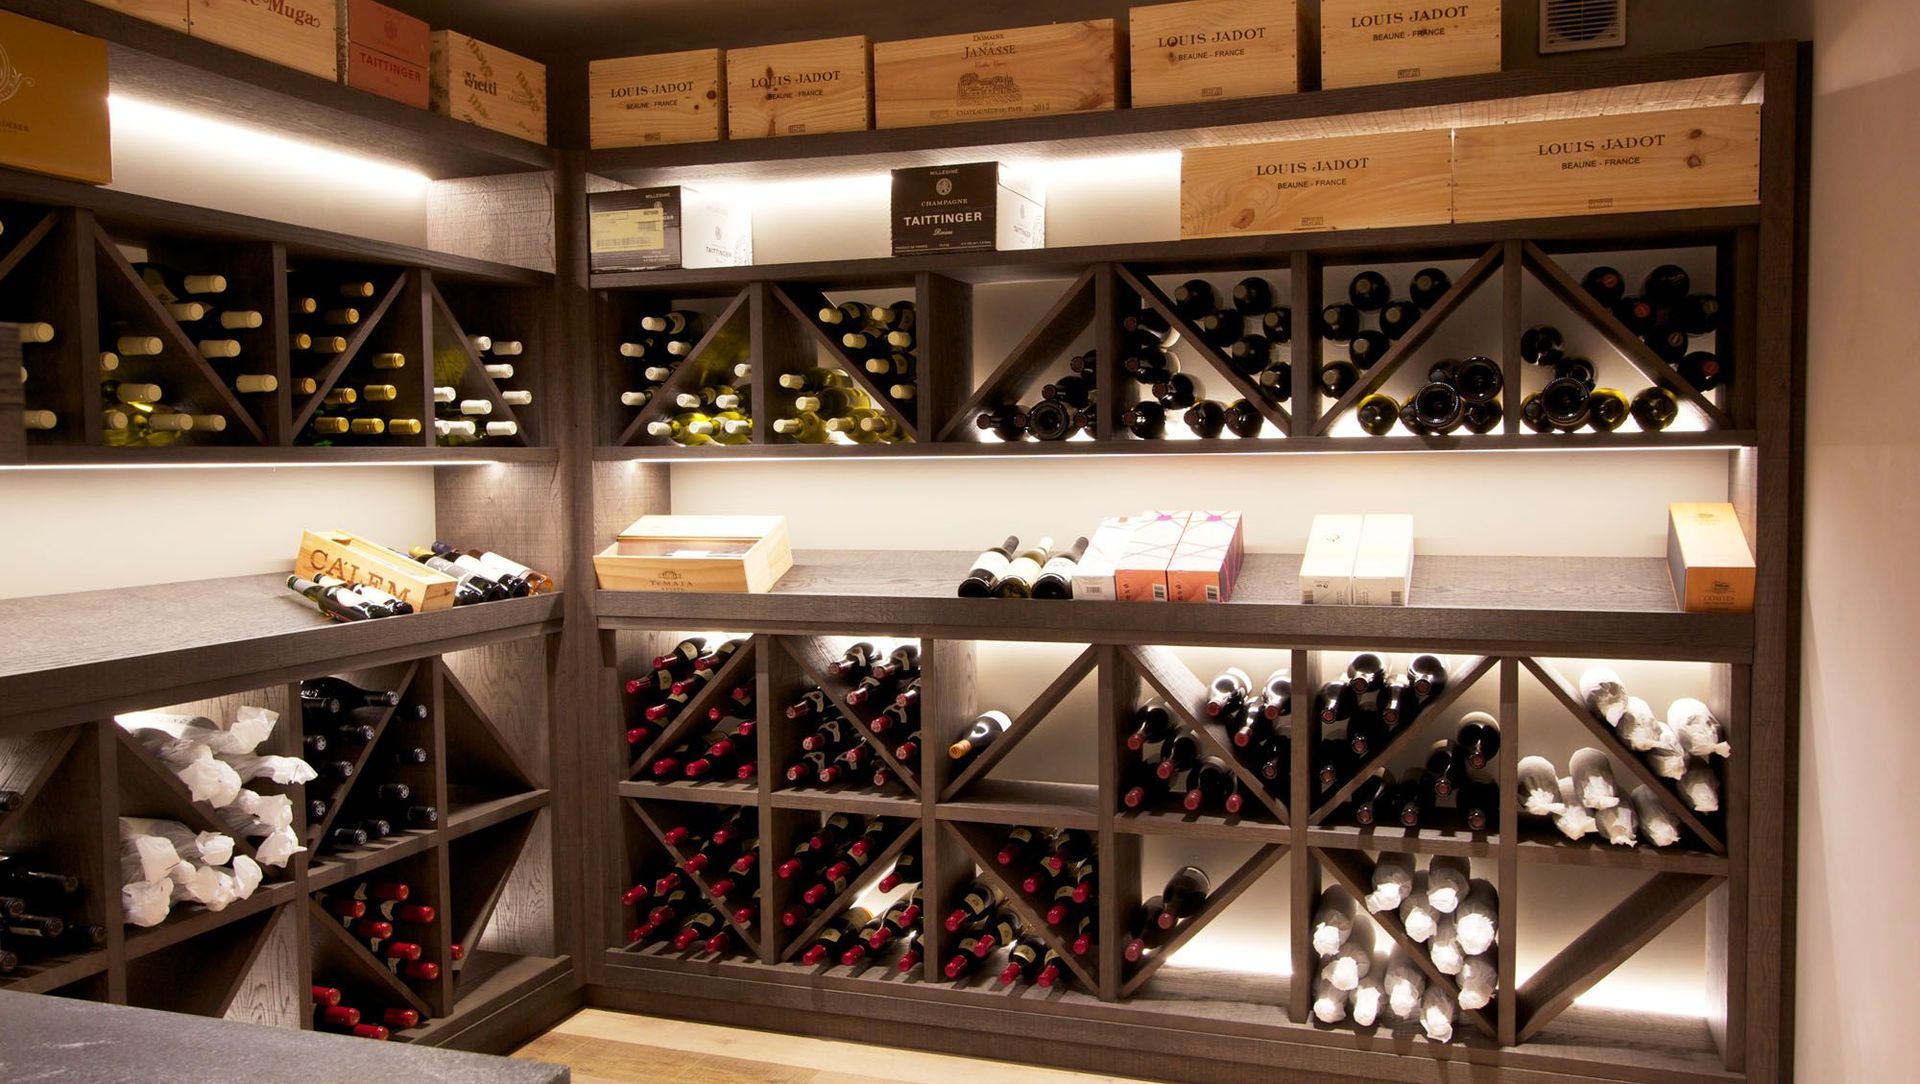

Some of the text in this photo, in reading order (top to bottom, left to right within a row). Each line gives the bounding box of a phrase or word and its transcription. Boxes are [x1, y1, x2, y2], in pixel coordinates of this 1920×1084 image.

[266, 0, 320, 28] Muga
[1351, 5, 1469, 28] LOUIS JADOT
[1158, 27, 1266, 48] LOUIS JADOT
[1373, 28, 1445, 41] BEAUNE FRANCE
[961, 44, 1017, 60] JANASSE
[1178, 48, 1245, 61] BEAUNE FRANCE
[360, 52, 422, 82] TAITTINGER
[464, 71, 498, 97] Vietti
[751, 70, 841, 88] LOUIS JADOT
[610, 81, 694, 98] LOUIS JADOT
[798, 89, 824, 97] FRANCE
[626, 102, 650, 110] BEAUNE
[1538, 134, 1666, 156] LOUIS JADOT
[1256, 157, 1369, 176] LOUIS JADOT
[1561, 156, 1641, 170] BEAUNE FRANCE
[1277, 178, 1347, 190] BEAUNE FRANCE
[920, 198, 968, 207] CHAMPAGNE
[903, 211, 983, 226] TAITTINGER
